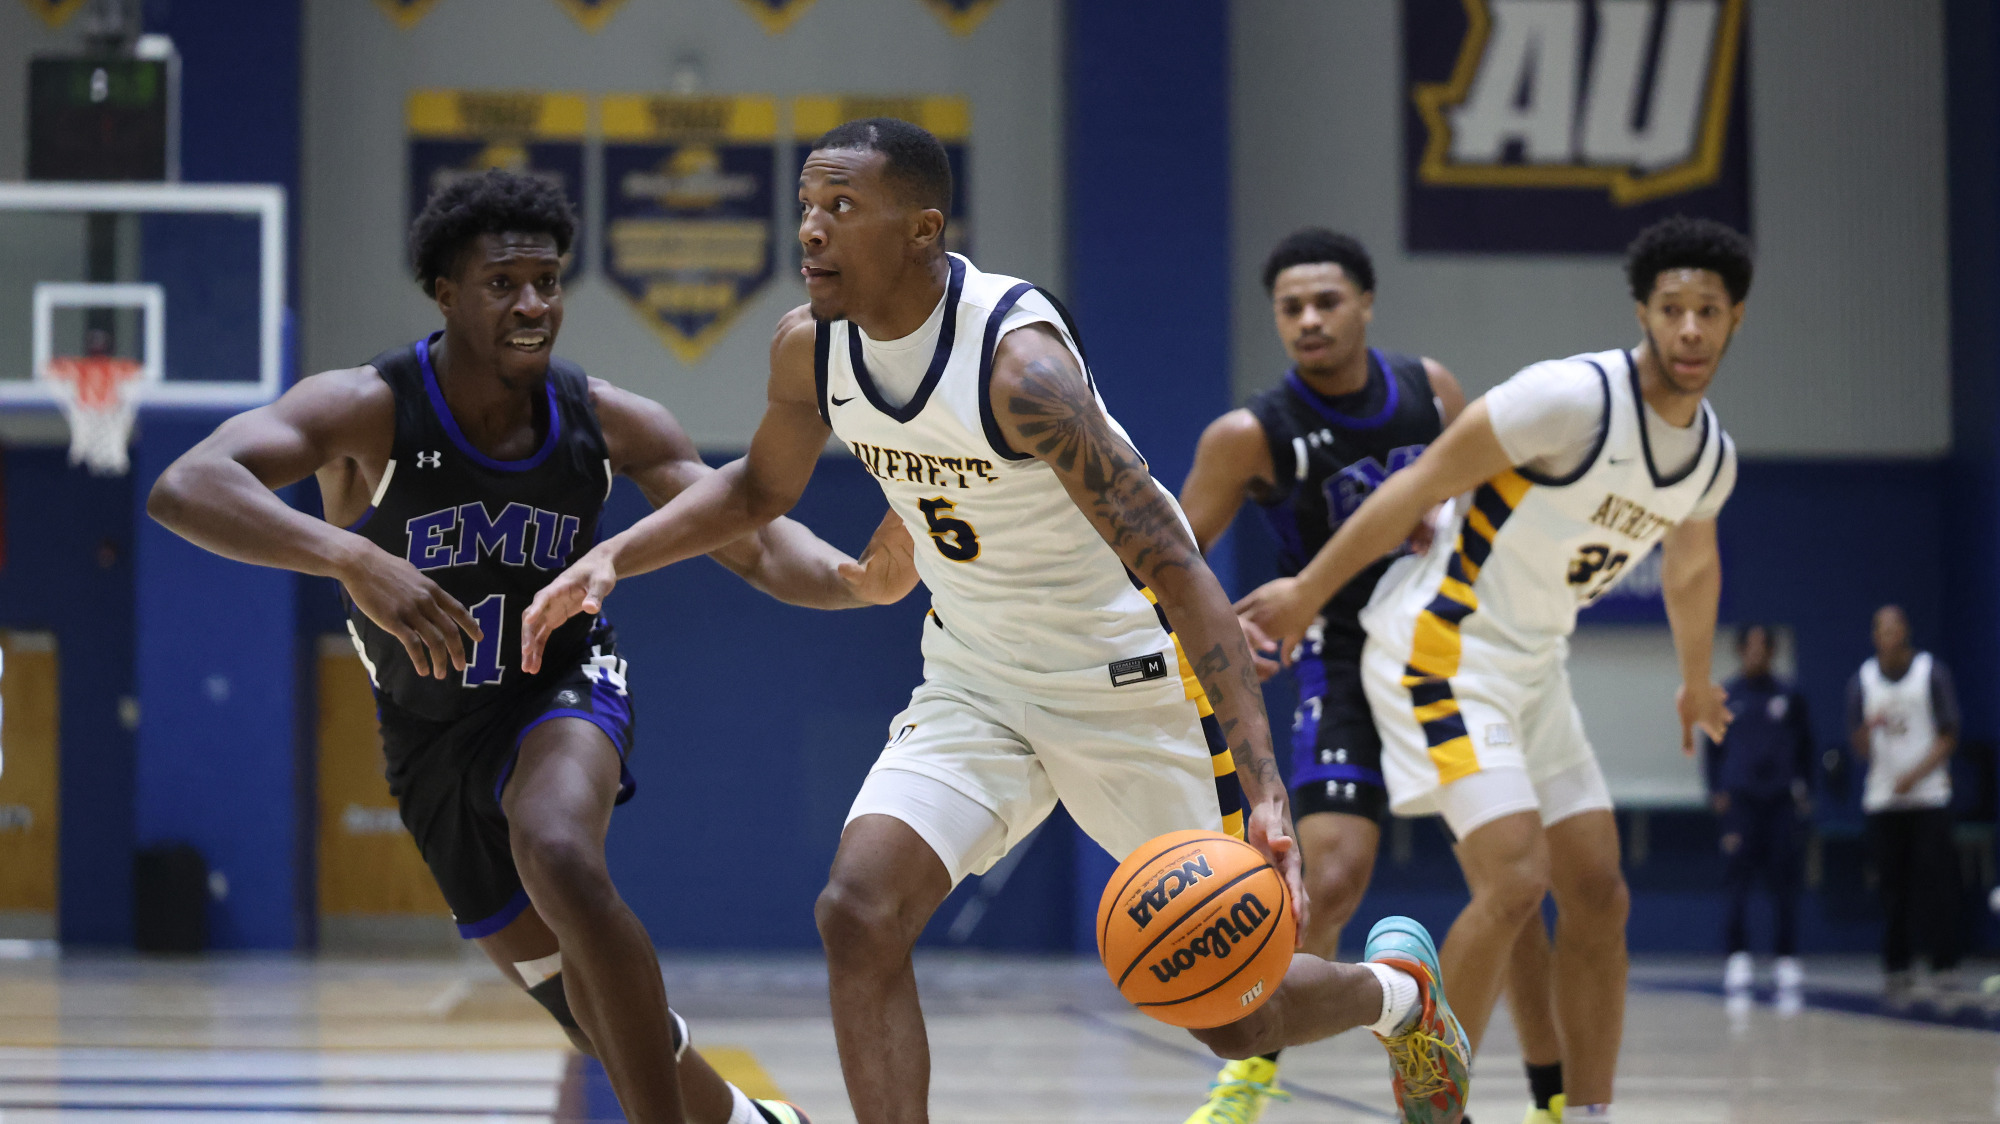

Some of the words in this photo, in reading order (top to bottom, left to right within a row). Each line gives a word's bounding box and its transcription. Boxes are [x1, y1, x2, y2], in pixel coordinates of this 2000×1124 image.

[1451, 0, 1717, 170] AU
[406, 501, 580, 571] EMU
[917, 495, 982, 563] 5
[462, 593, 506, 688] 1
[1148, 660, 1159, 673] M
[1127, 853, 1214, 929] NCAA
[1149, 892, 1271, 983] Wilson
[1240, 978, 1264, 1008] AU
